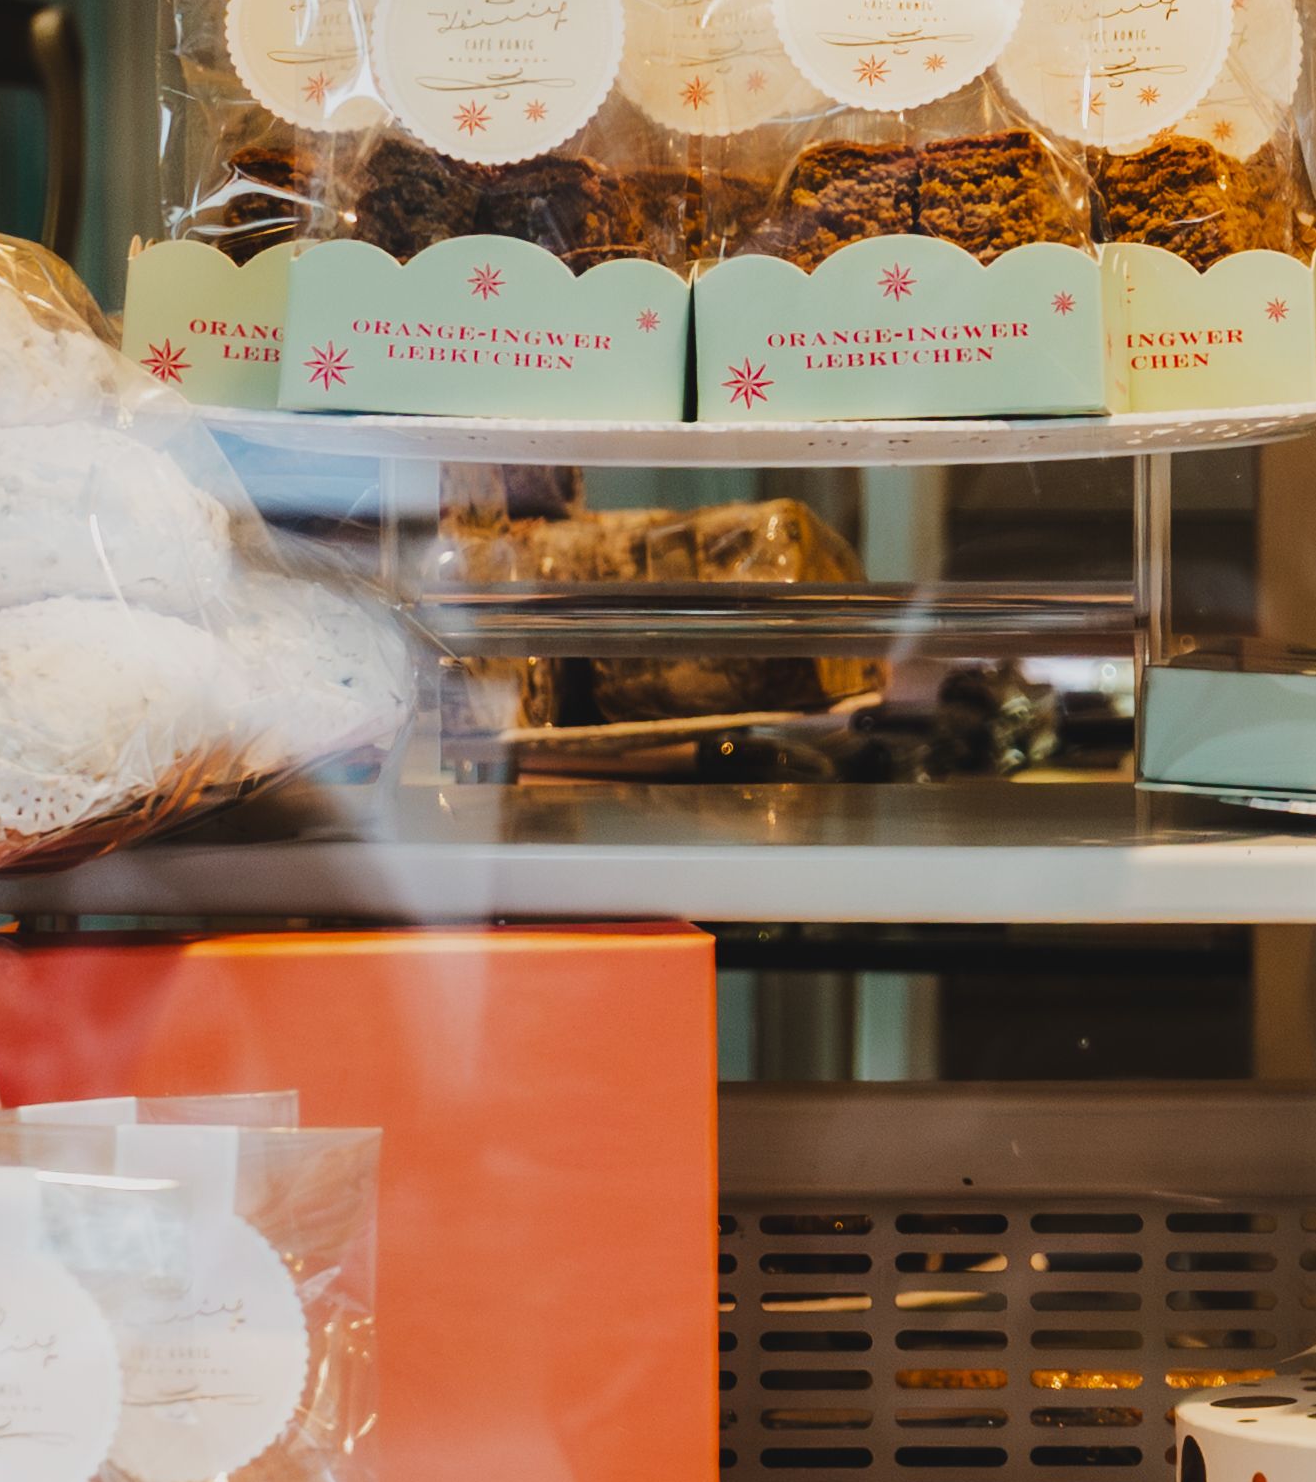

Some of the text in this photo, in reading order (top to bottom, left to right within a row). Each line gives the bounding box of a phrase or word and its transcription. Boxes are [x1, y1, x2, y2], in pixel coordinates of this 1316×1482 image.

[352, 319, 613, 351] ORANGE-INGWER
[767, 322, 1030, 349] ORANGE-INGWER
[223, 344, 280, 363] LEB
[388, 344, 575, 371] LEBKUCHEN
[805, 345, 996, 369] LEBKUCHEN
[1130, 353, 1209, 370] CHEN
